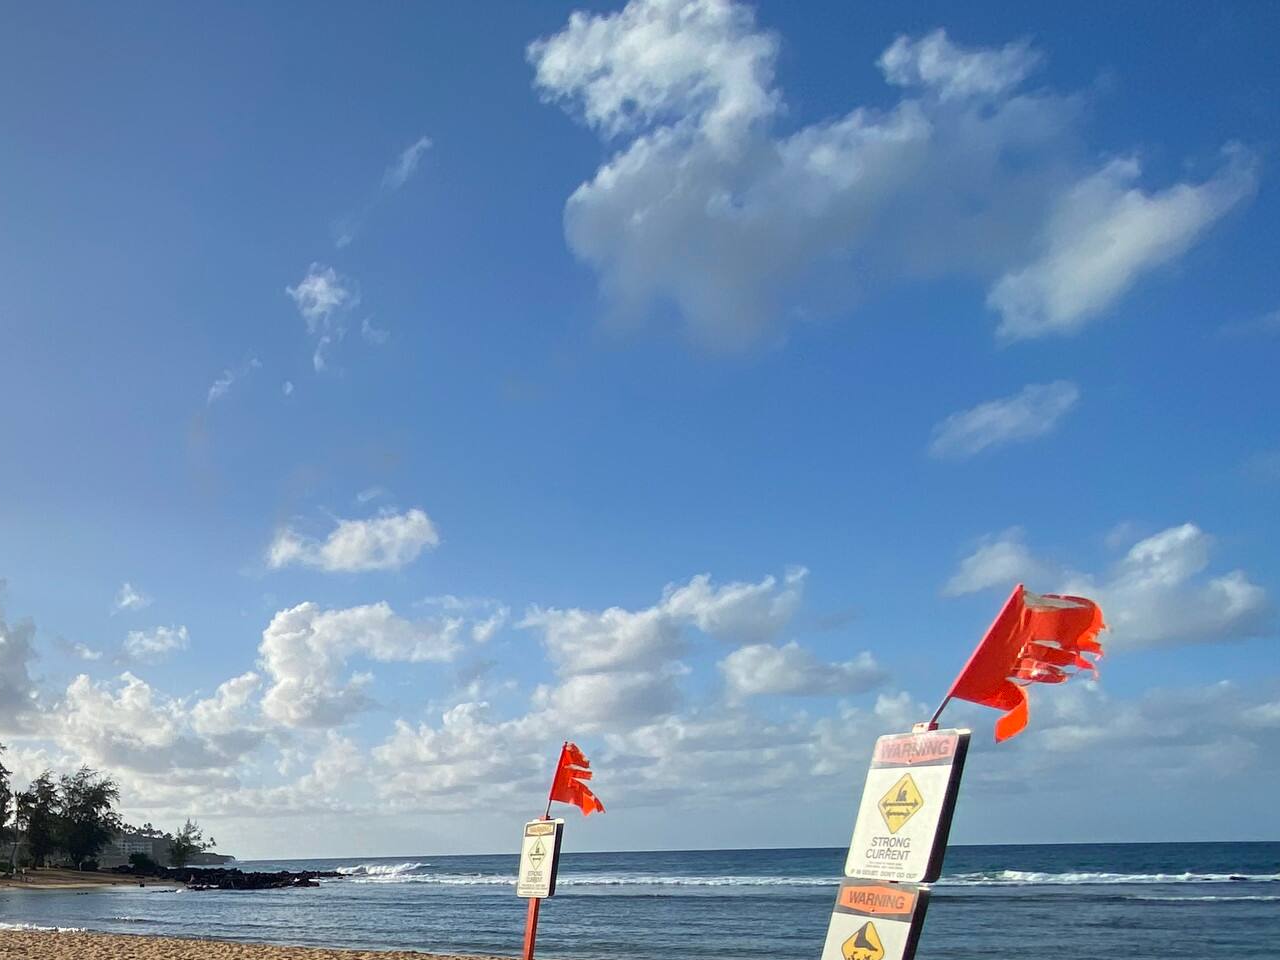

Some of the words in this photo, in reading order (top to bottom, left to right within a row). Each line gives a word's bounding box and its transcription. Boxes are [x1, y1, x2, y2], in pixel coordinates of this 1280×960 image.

[881, 739, 950, 759] WARNING
[871, 837, 911, 848] STRONG
[866, 848, 911, 860] CURRENT
[849, 891, 905, 909] WARNING
